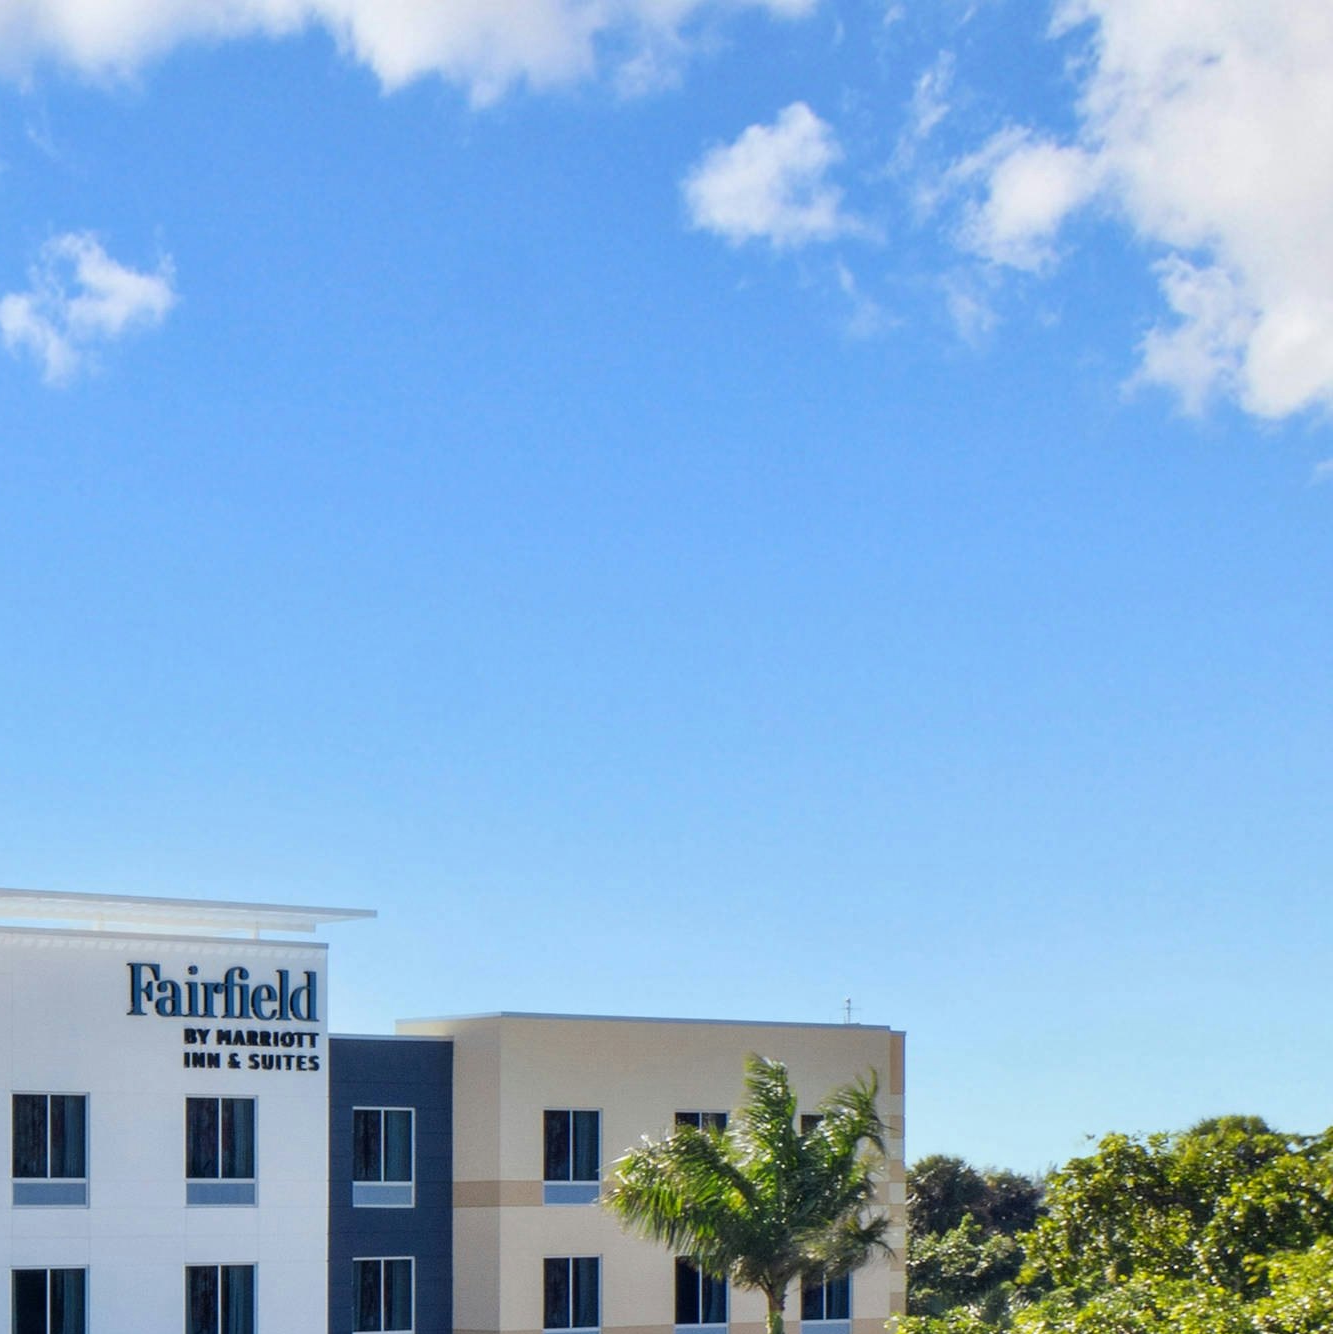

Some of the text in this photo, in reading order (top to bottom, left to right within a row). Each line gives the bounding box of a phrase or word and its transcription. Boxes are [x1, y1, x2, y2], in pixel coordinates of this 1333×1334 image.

[126, 962, 320, 1022] Fairfield
[183, 1028, 320, 1048] BY MARRIOTT
[183, 1052, 320, 1071] INN & SUITES
